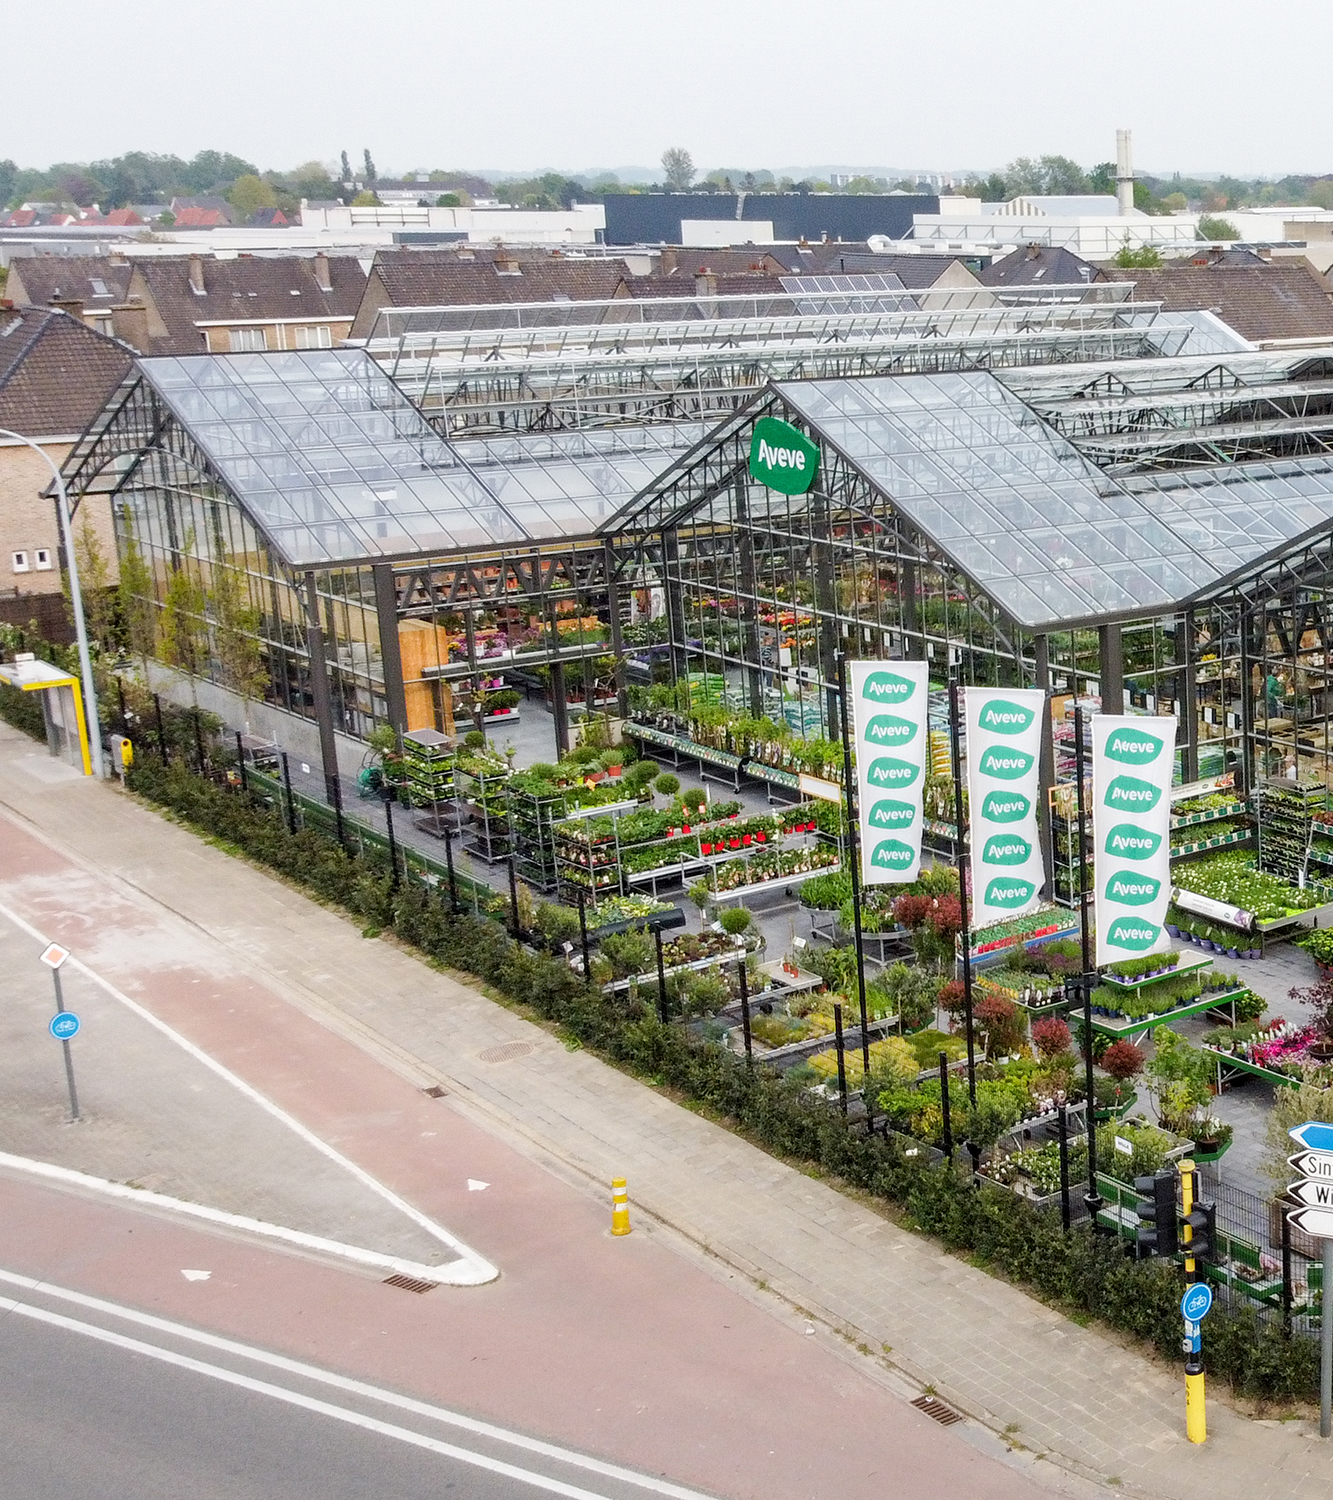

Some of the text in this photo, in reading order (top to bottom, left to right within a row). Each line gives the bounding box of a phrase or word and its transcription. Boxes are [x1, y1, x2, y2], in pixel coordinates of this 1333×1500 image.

[758, 439, 805, 470] Aveve
[870, 681, 908, 696] Aveve
[985, 710, 1026, 725] Aveve
[871, 724, 910, 738] Aveve
[1112, 739, 1154, 754] Aveve
[986, 756, 1026, 771] Aveve
[873, 767, 911, 781] Aveve
[1112, 787, 1153, 802] Aveve
[988, 801, 1025, 815] Aveve
[875, 809, 913, 822] Aveve
[1112, 835, 1153, 850] Aveve
[878, 848, 911, 861] Aveve
[988, 844, 1026, 858] Aveve
[991, 887, 1027, 900] Aveve
[1113, 881, 1154, 896] Aveve
[1114, 927, 1153, 940] Aveve
